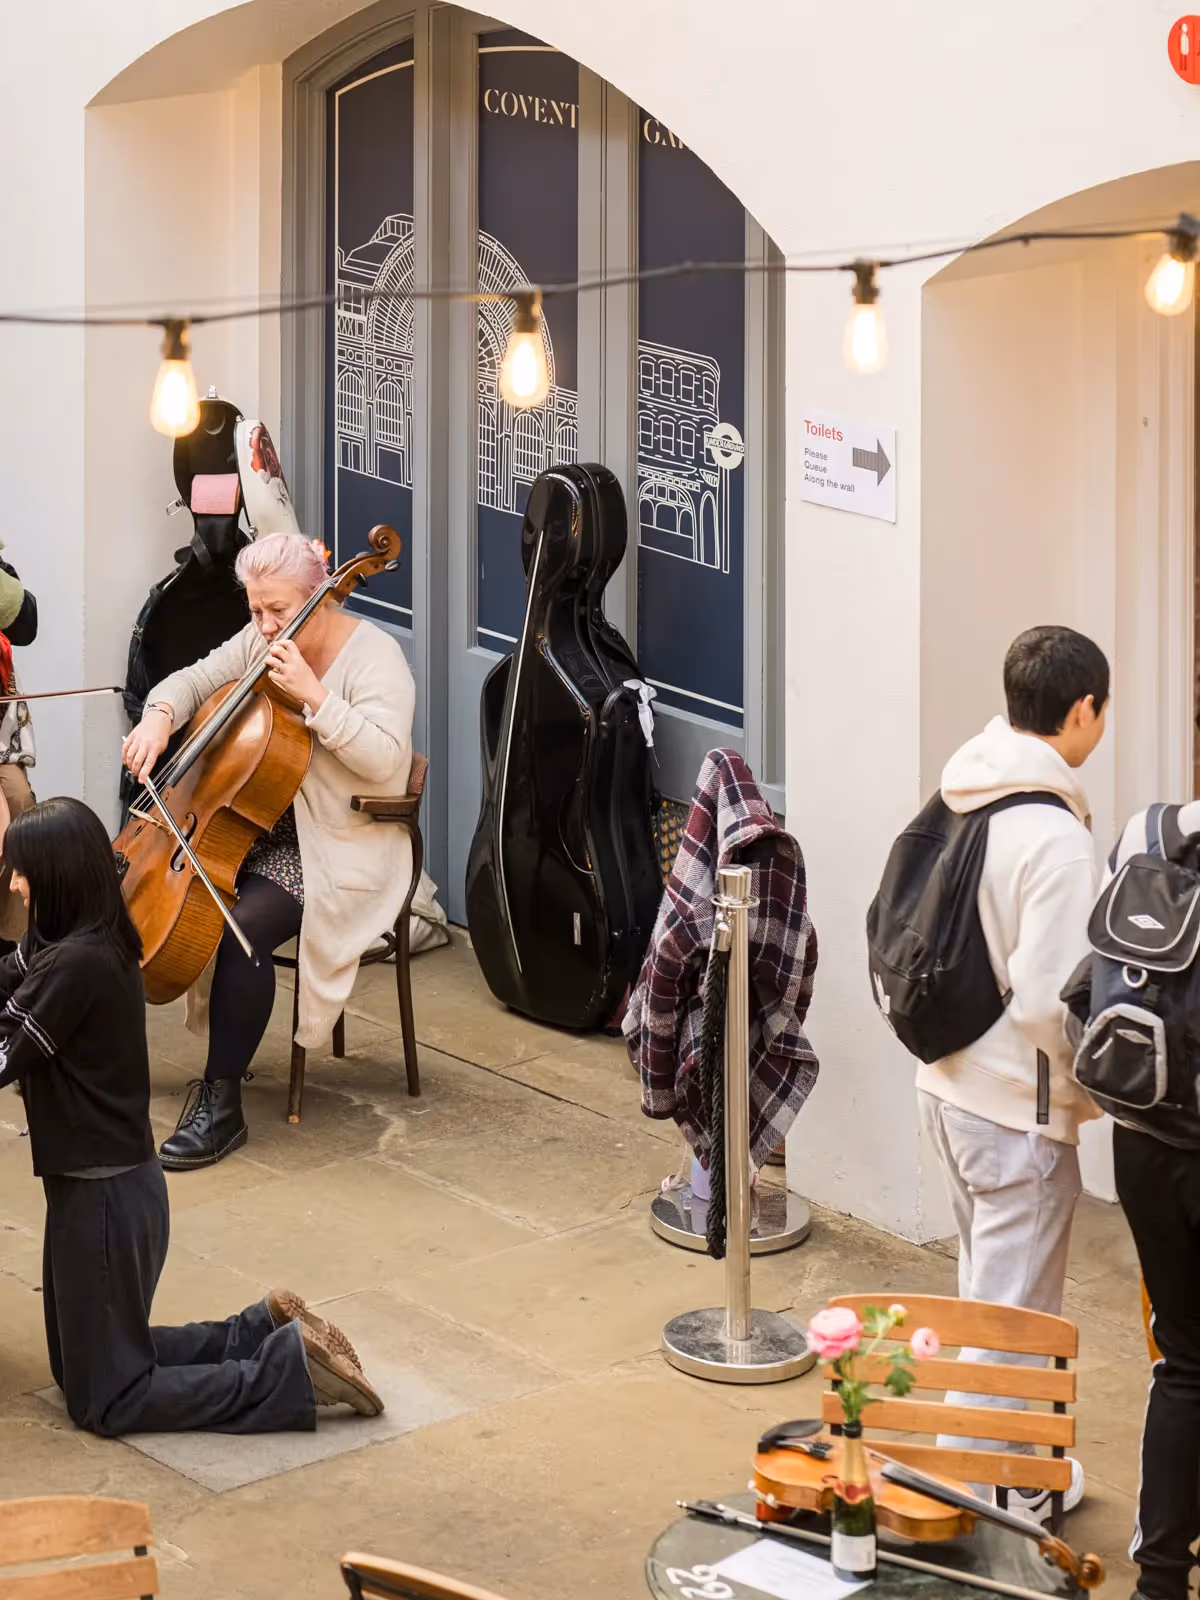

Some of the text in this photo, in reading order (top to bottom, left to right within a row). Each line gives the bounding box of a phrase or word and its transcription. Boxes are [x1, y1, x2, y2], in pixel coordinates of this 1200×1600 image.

[484, 88, 580, 128] COVENT
[804, 420, 844, 442] Toilets
[804, 448, 828, 460] Please
[804, 460, 827, 473] Queue
[804, 473, 855, 492] Along the wall
